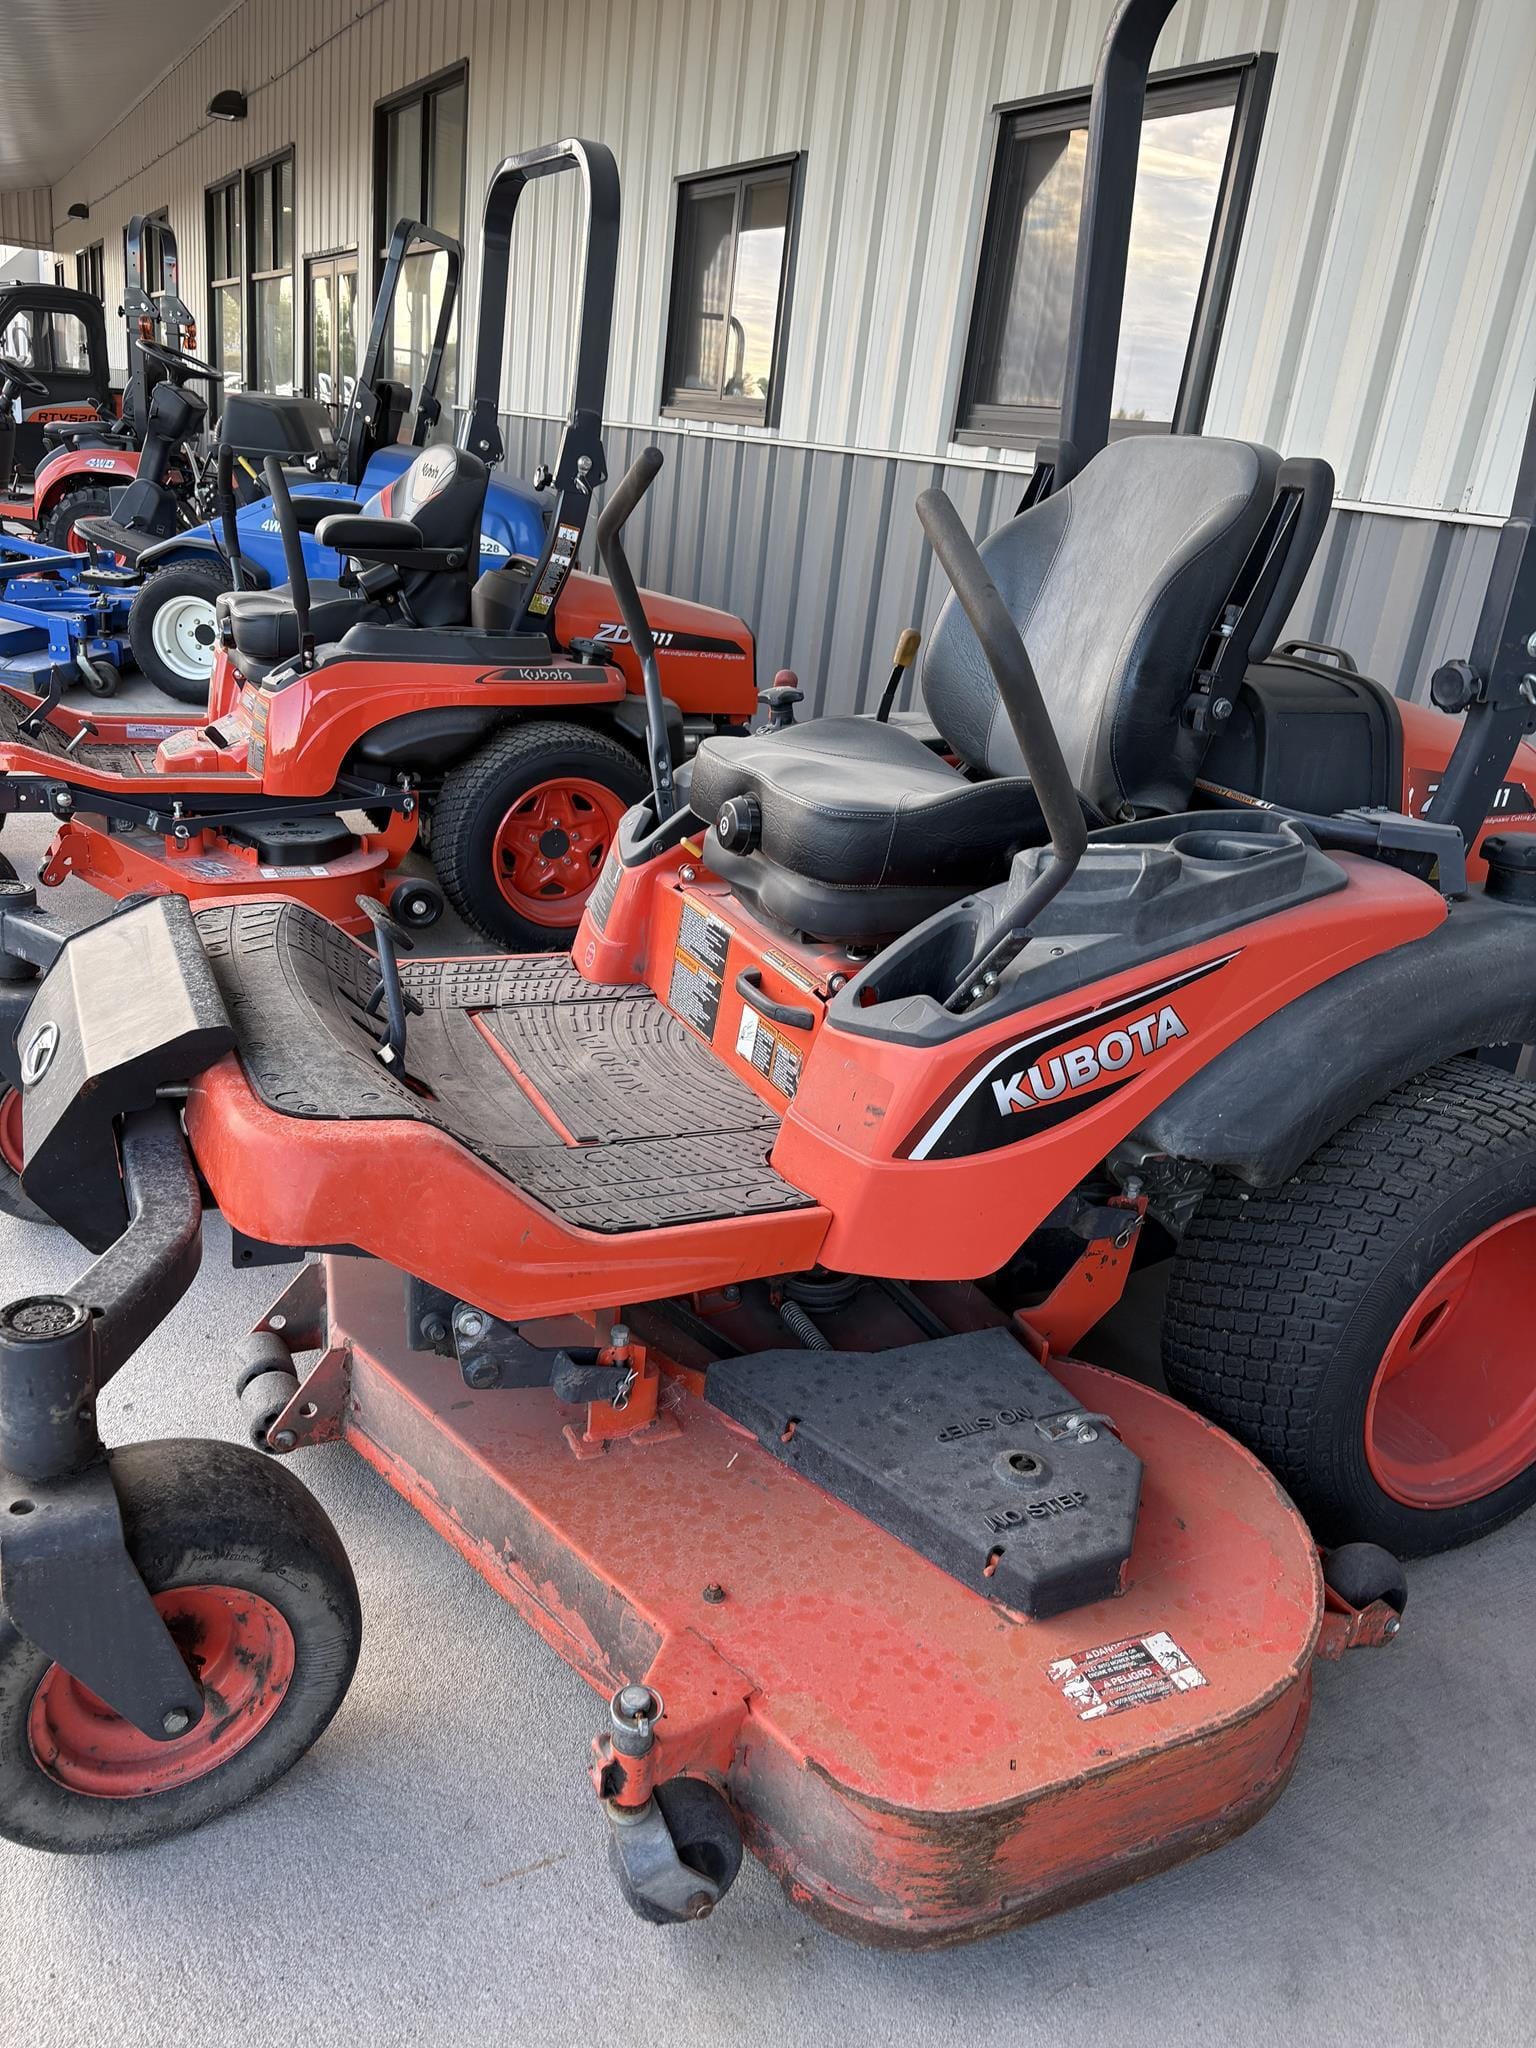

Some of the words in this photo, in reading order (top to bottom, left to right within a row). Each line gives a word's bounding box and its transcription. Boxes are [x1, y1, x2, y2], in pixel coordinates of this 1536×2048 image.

[520, 668, 572, 681] Kubota
[992, 1004, 1189, 1117] KUBOTA
[983, 1509, 1026, 1533] NO
[1026, 1491, 1088, 1518] STEP
[1110, 1667, 1152, 1686] PELIGRO
